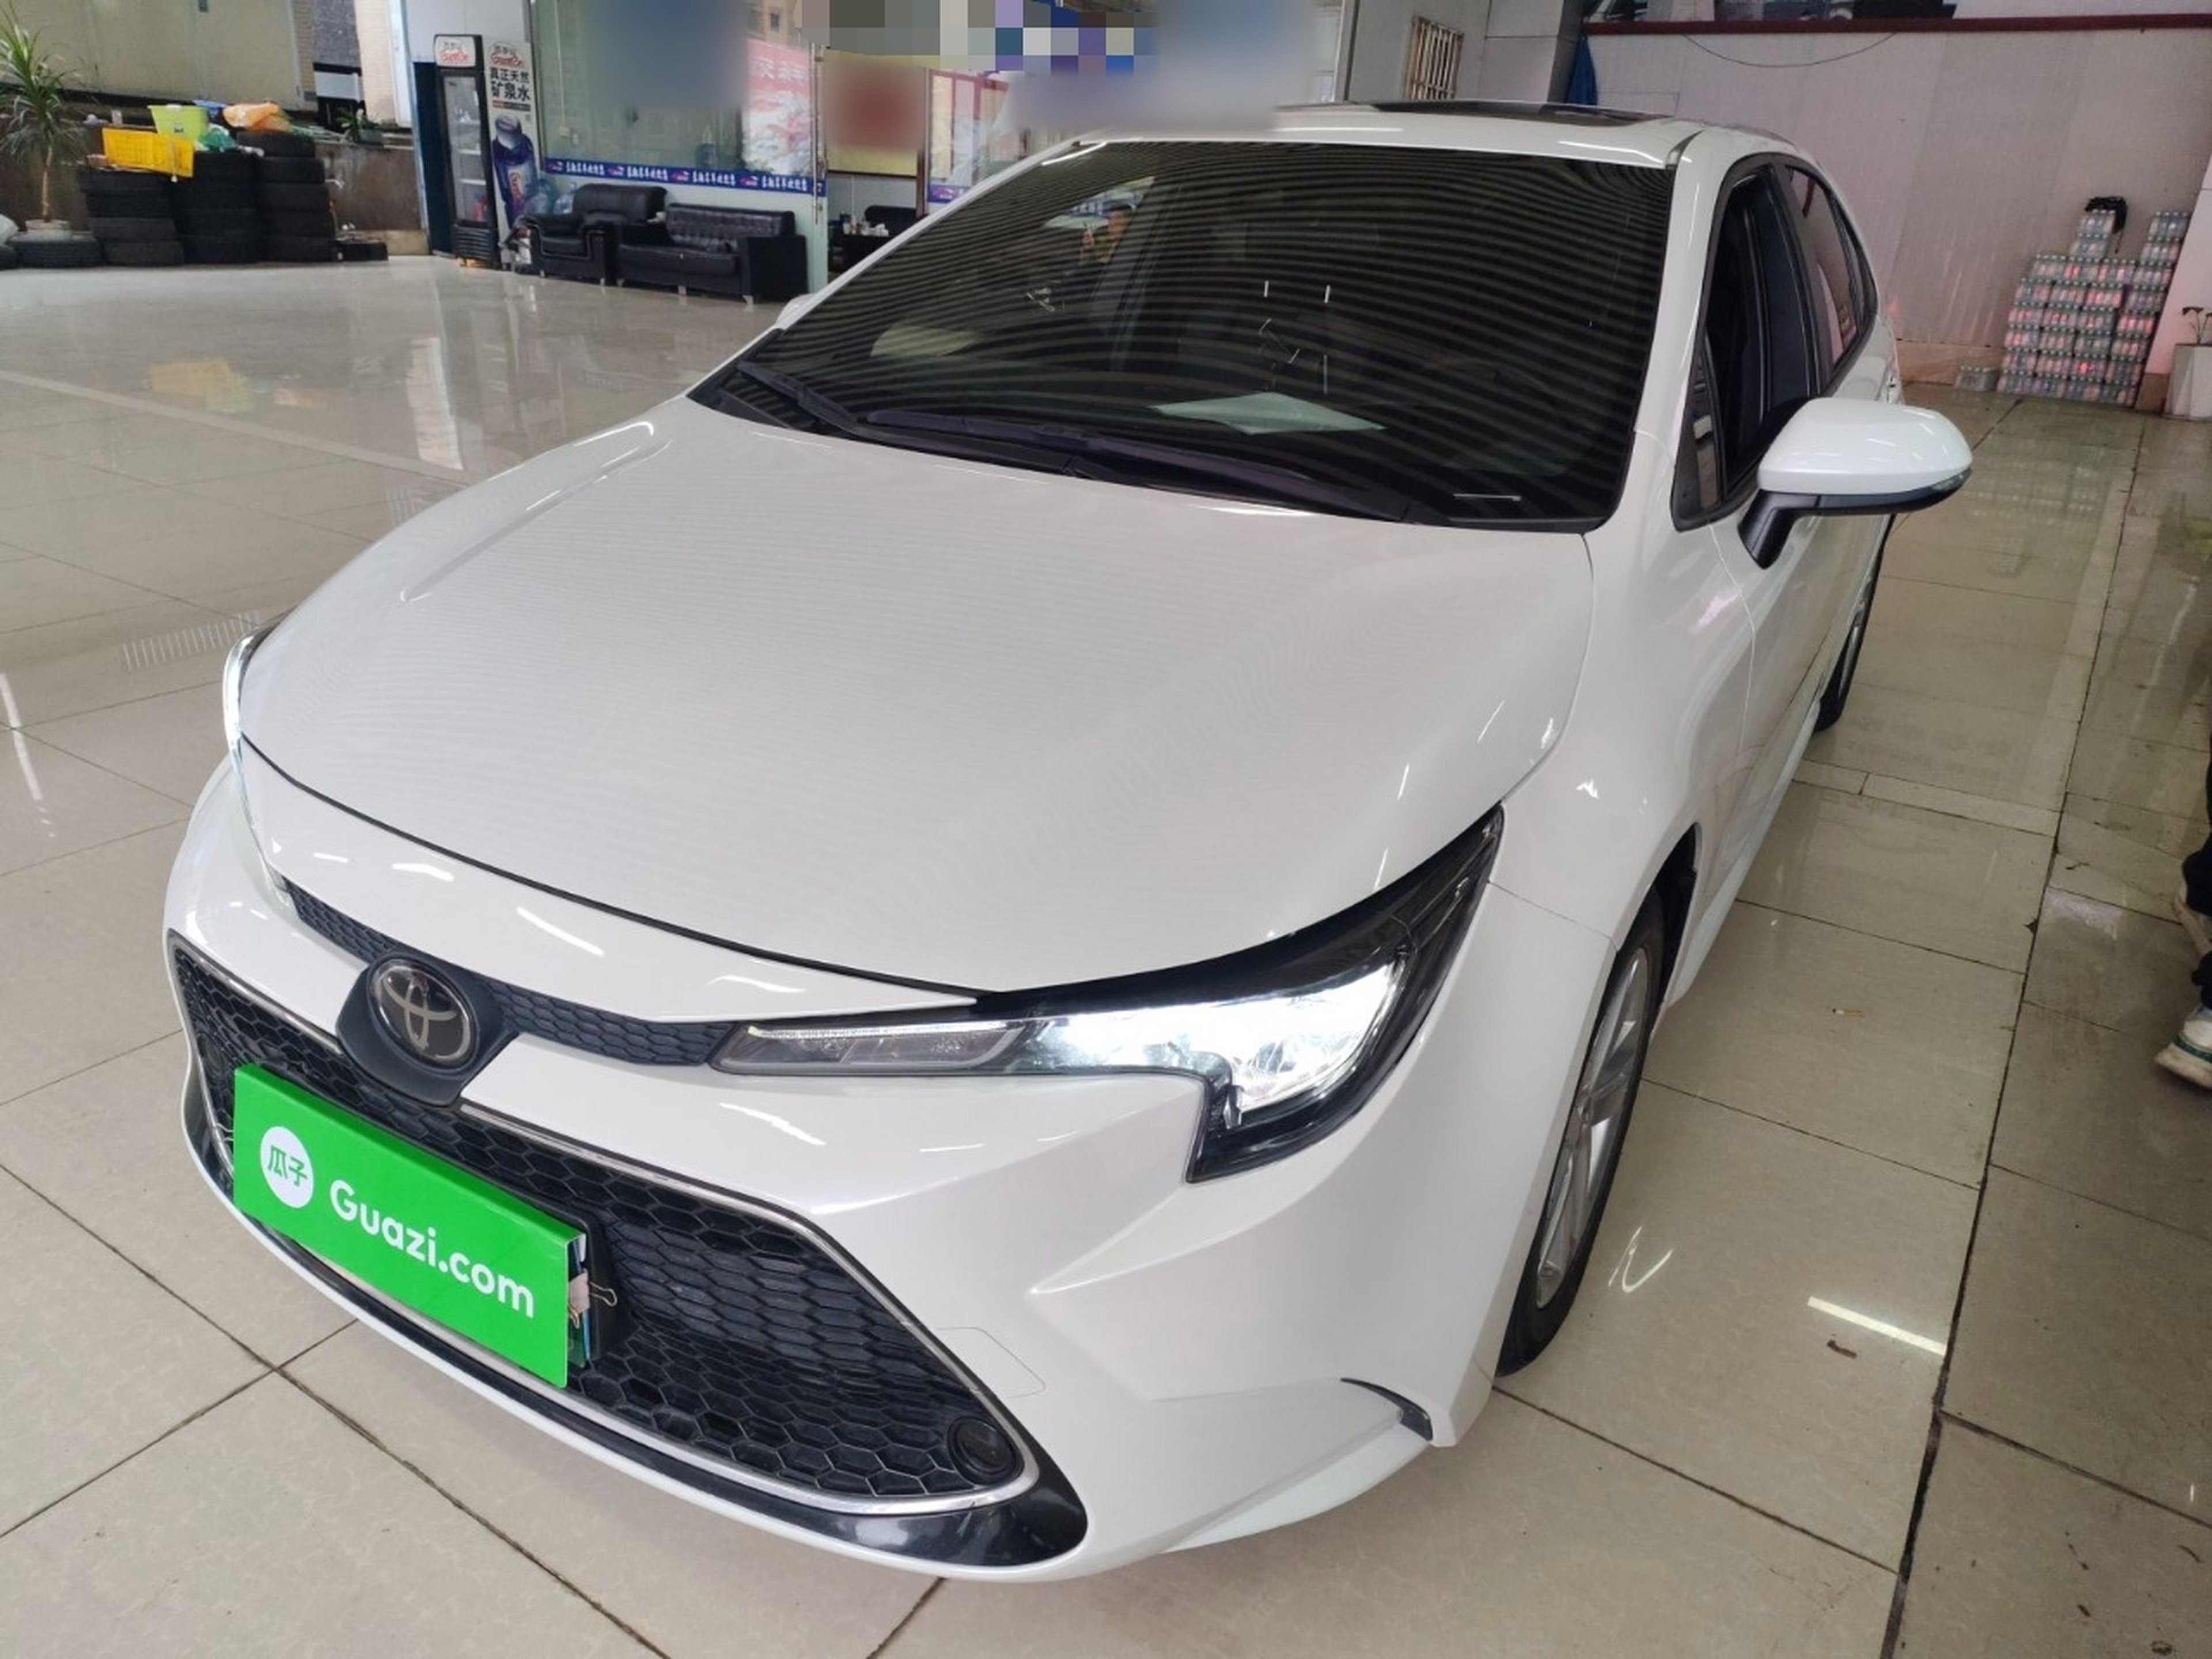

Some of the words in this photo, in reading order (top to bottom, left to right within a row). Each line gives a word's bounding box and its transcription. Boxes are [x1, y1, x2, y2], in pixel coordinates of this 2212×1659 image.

[491, 81, 531, 101] 矿泉水
[267, 1145, 308, 1187] 瓜子
[331, 1180, 533, 1318] Guazi.com
